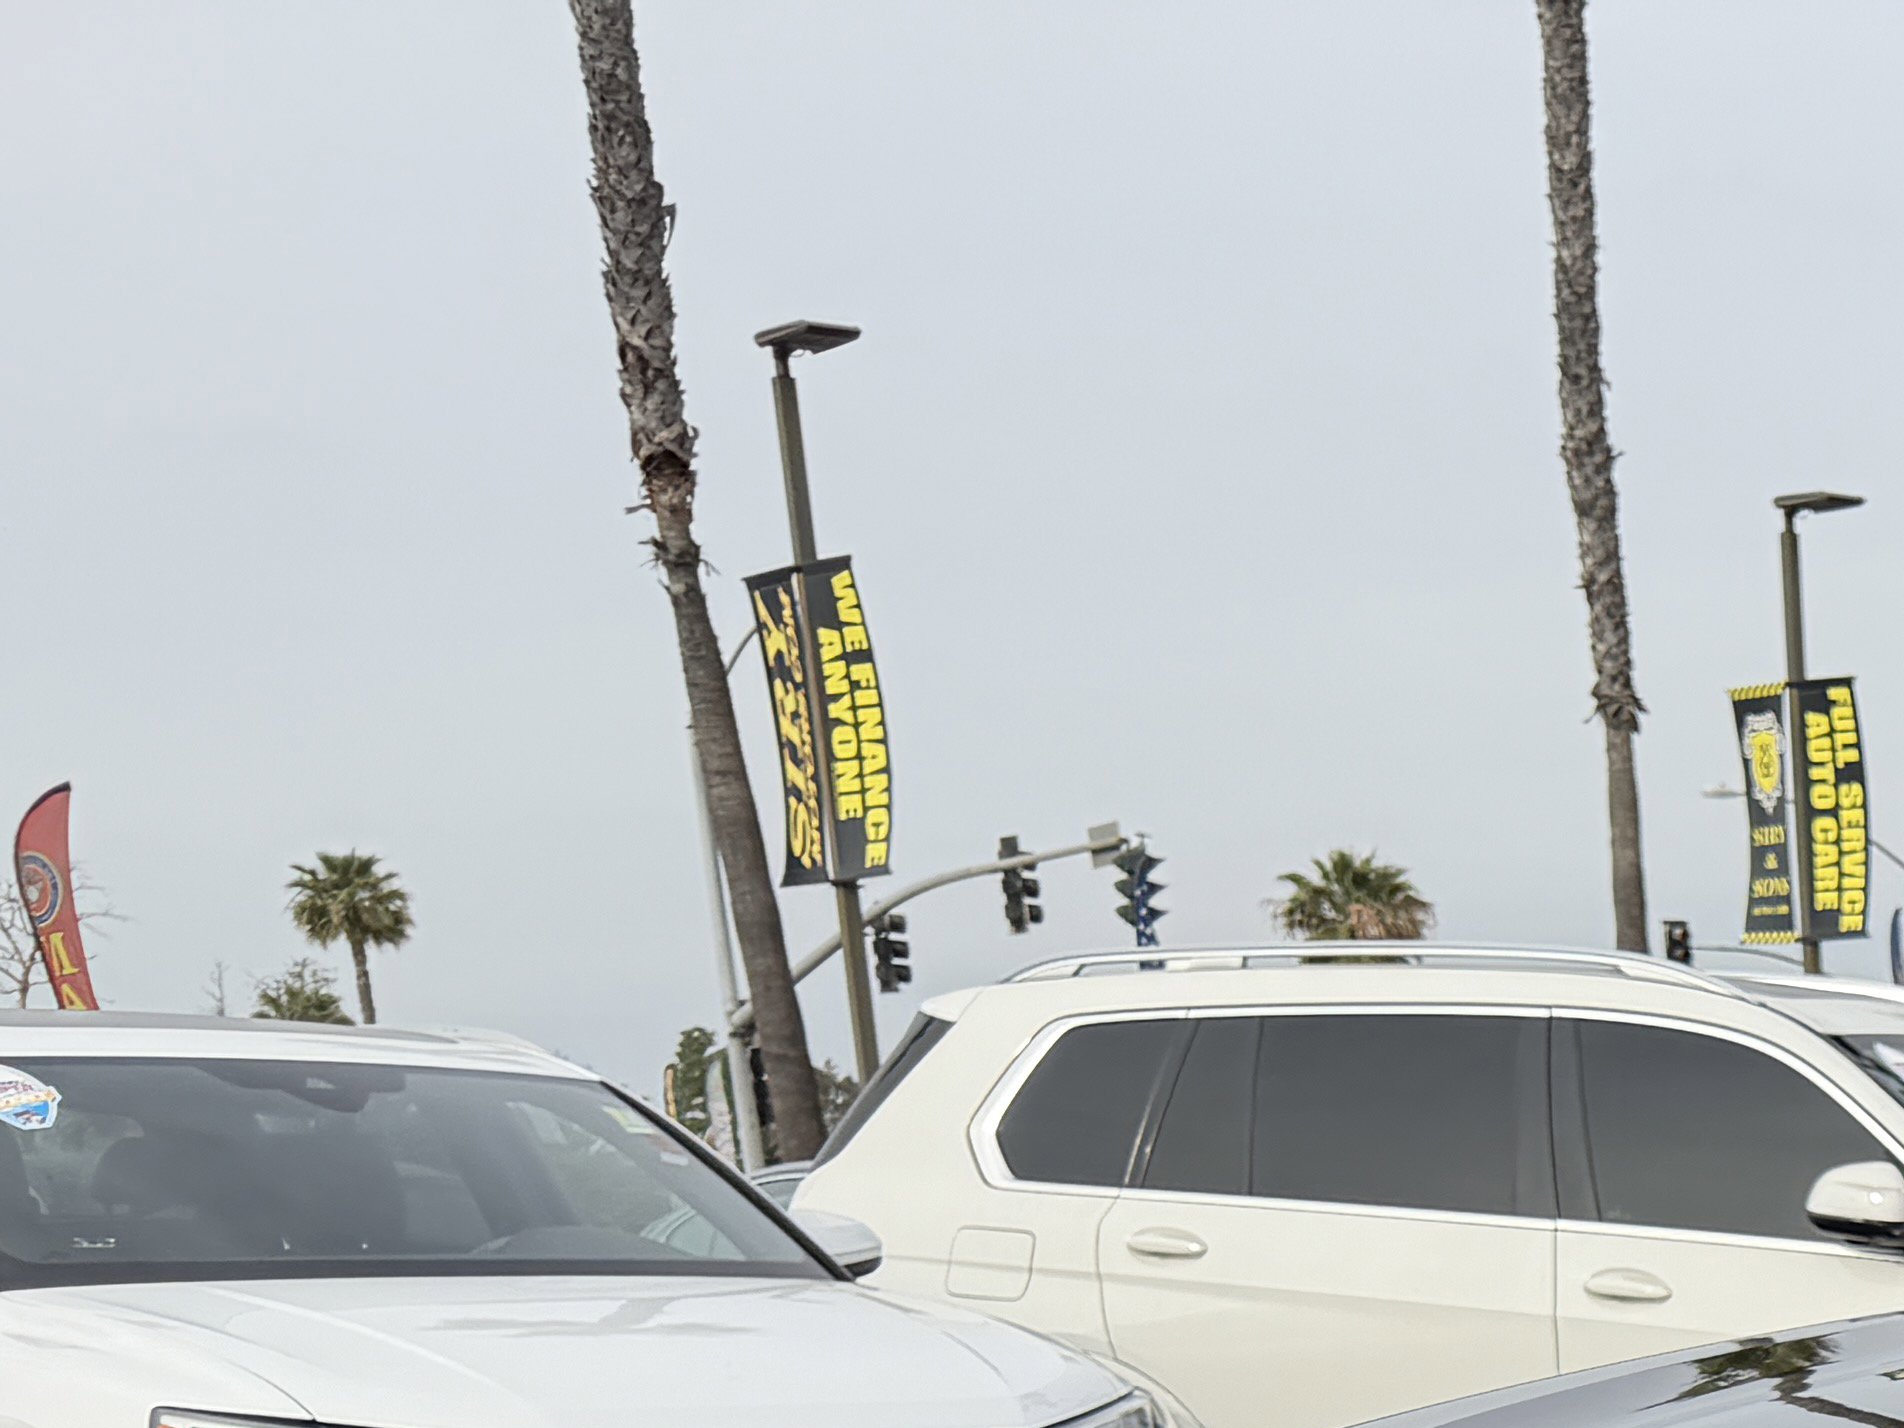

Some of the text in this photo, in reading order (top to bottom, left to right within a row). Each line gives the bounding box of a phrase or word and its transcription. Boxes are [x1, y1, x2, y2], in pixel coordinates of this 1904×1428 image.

[816, 627, 864, 821] ANYONE
[831, 570, 890, 868] WE FINANCE
[1804, 710, 1839, 911] AUTO CARE
[1826, 686, 1866, 932] FULL SERVICE
